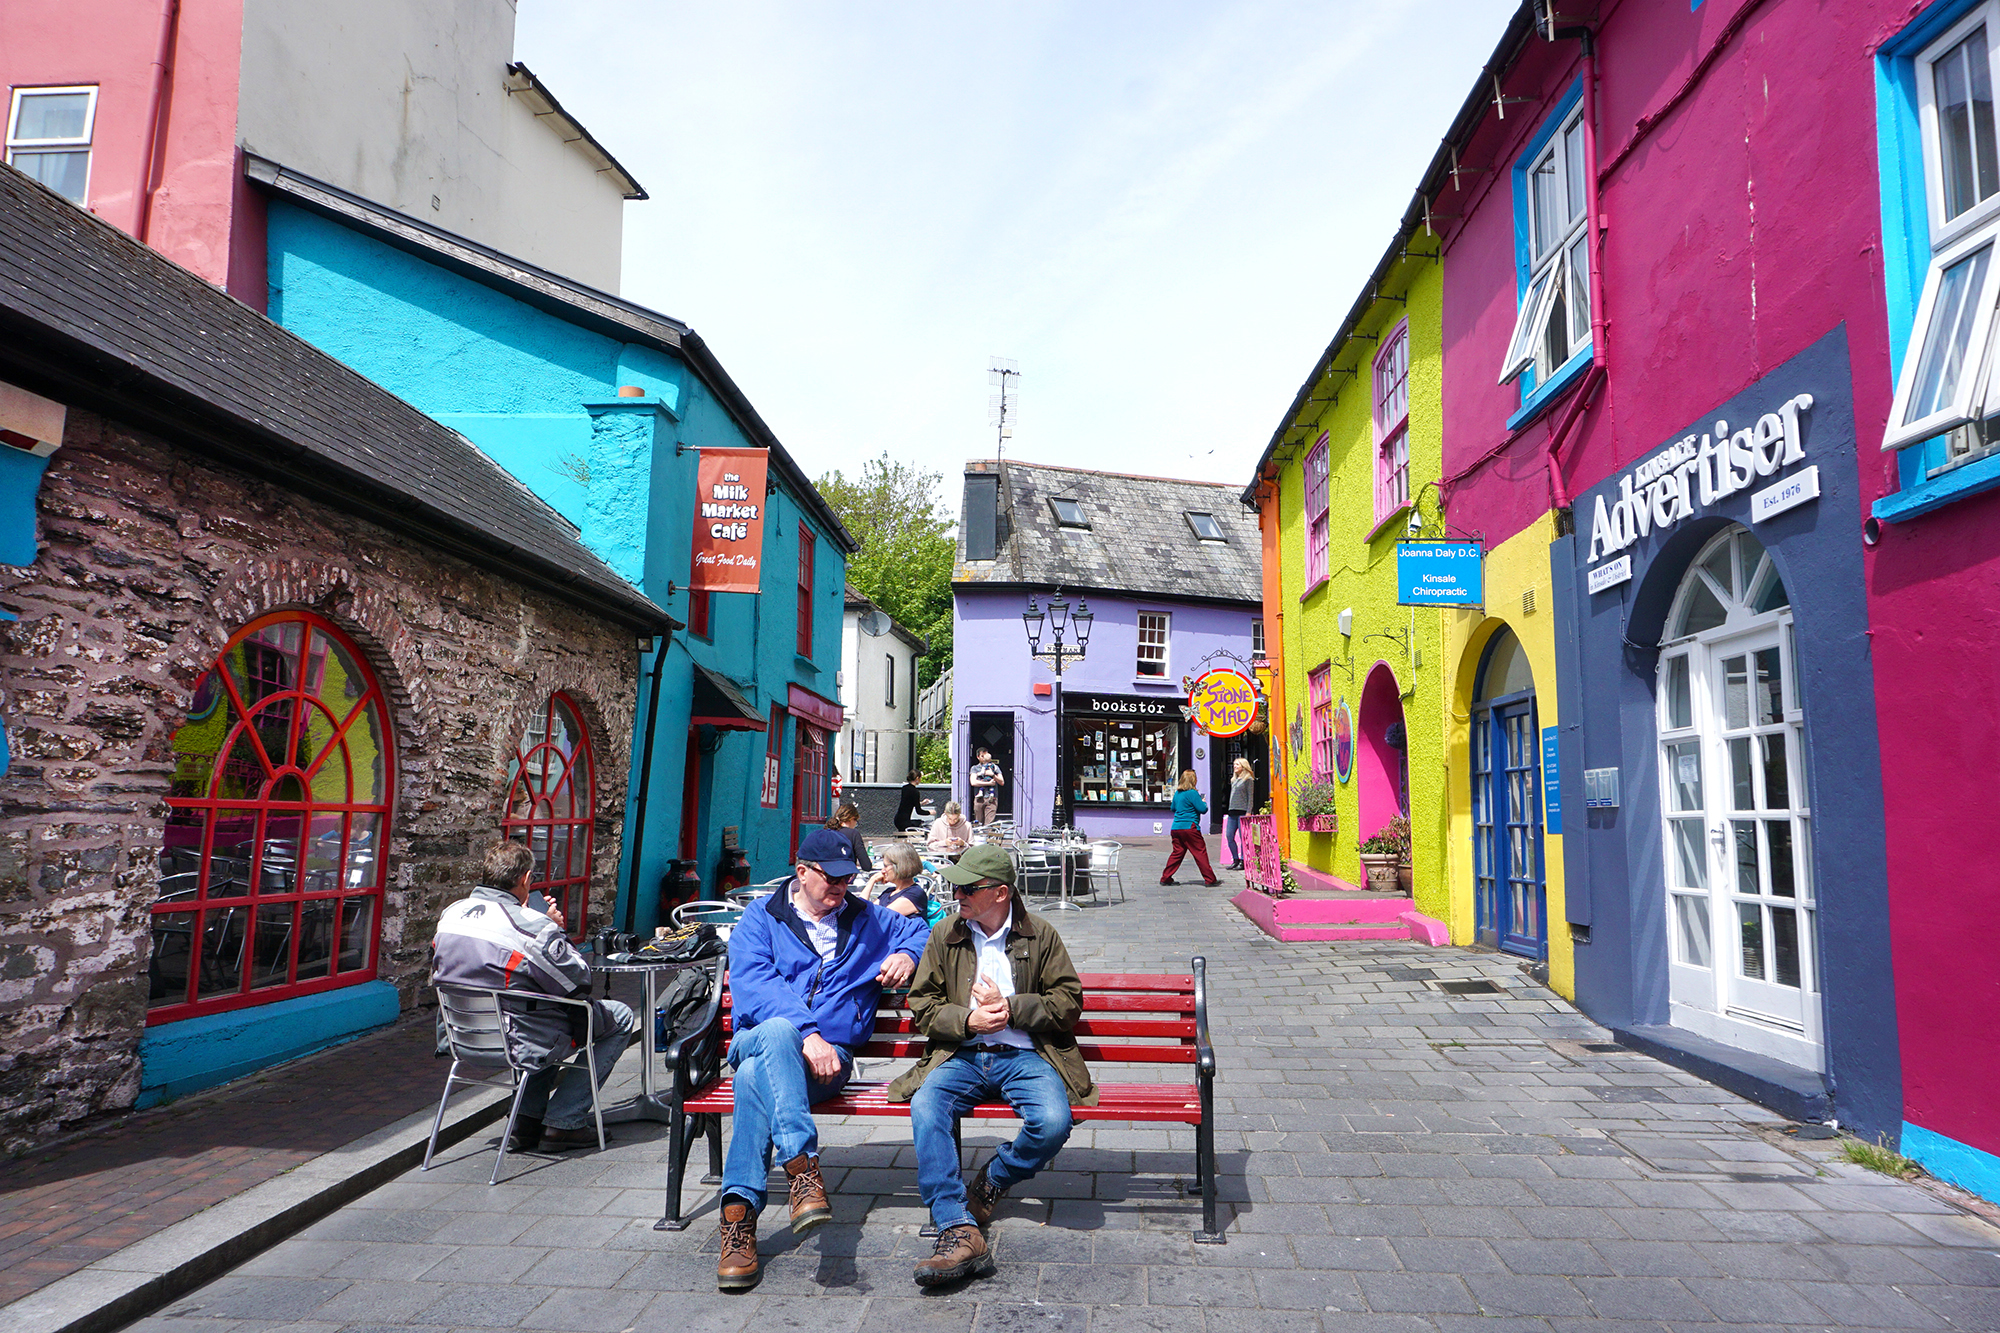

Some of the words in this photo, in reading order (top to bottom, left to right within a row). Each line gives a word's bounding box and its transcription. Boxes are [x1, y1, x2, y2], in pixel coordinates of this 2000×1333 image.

[1635, 434, 1697, 489] KINSALE
[724, 473, 740, 482] the
[1587, 393, 1813, 564] Advertiser
[712, 484, 749, 501] Milk
[1763, 496, 1779, 509] Est.
[1781, 483, 1801, 501] 1976
[701, 502, 758, 520] Market
[710, 522, 748, 541] Café
[695, 552, 716, 567] Great
[717, 553, 736, 567] Food
[736, 554, 757, 569] Daily
[1399, 548, 1433, 557] Joanna
[1435, 548, 1456, 559] Daly
[1458, 548, 1479, 557] D.C.
[1422, 574, 1456, 583] Kinsale
[1412, 586, 1467, 597] Chiropractic
[1203, 679, 1253, 711] STONE
[1092, 699, 1165, 714] bookstór
[1209, 706, 1249, 727] MAD
